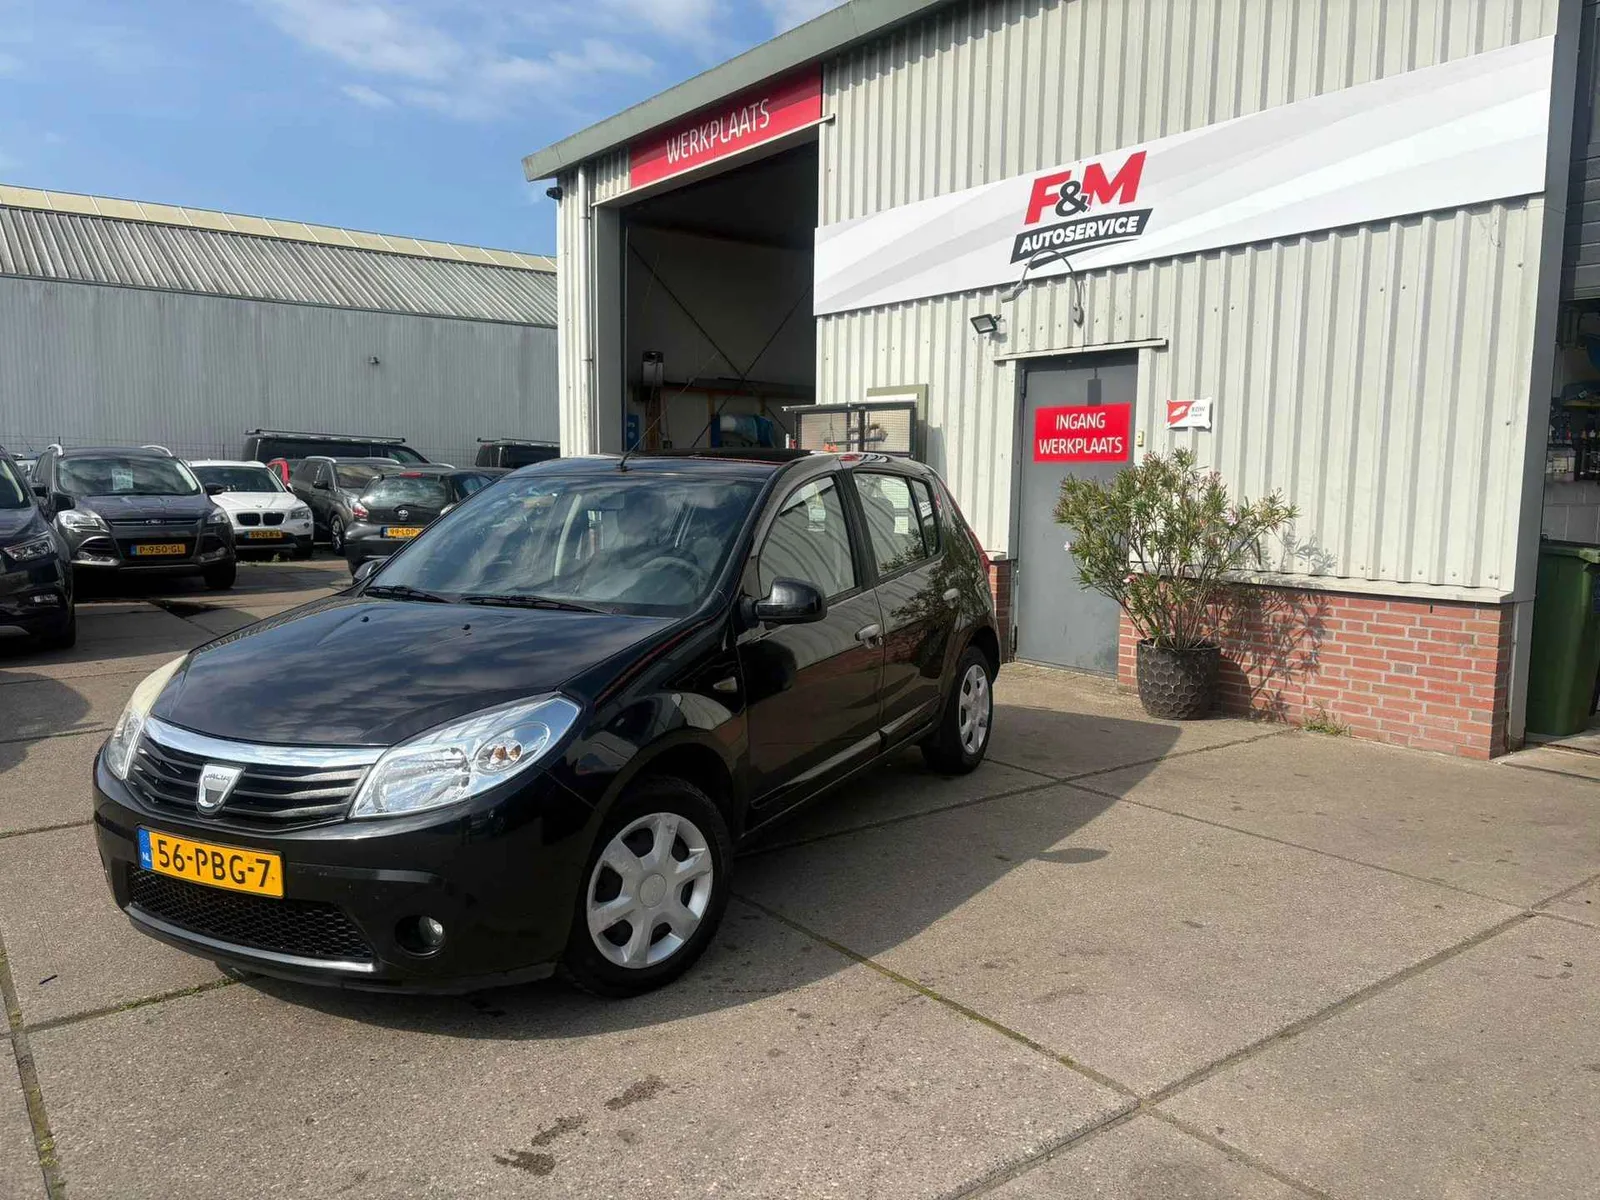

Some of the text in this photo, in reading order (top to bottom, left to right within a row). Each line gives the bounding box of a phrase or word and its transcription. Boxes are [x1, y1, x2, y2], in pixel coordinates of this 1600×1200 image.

[666, 98, 770, 164] WERKPLAATS
[1024, 150, 1147, 226] F&M
[1020, 216, 1140, 254] AUTOSERVICE
[1056, 412, 1106, 430] INGANG
[1039, 437, 1123, 455] WERKPLAATS
[389, 528, 421, 536] 99-LDP-
[139, 545, 182, 554] P-950-GL
[142, 851, 151, 862] NL
[157, 839, 271, 888] 56-PBG-7
